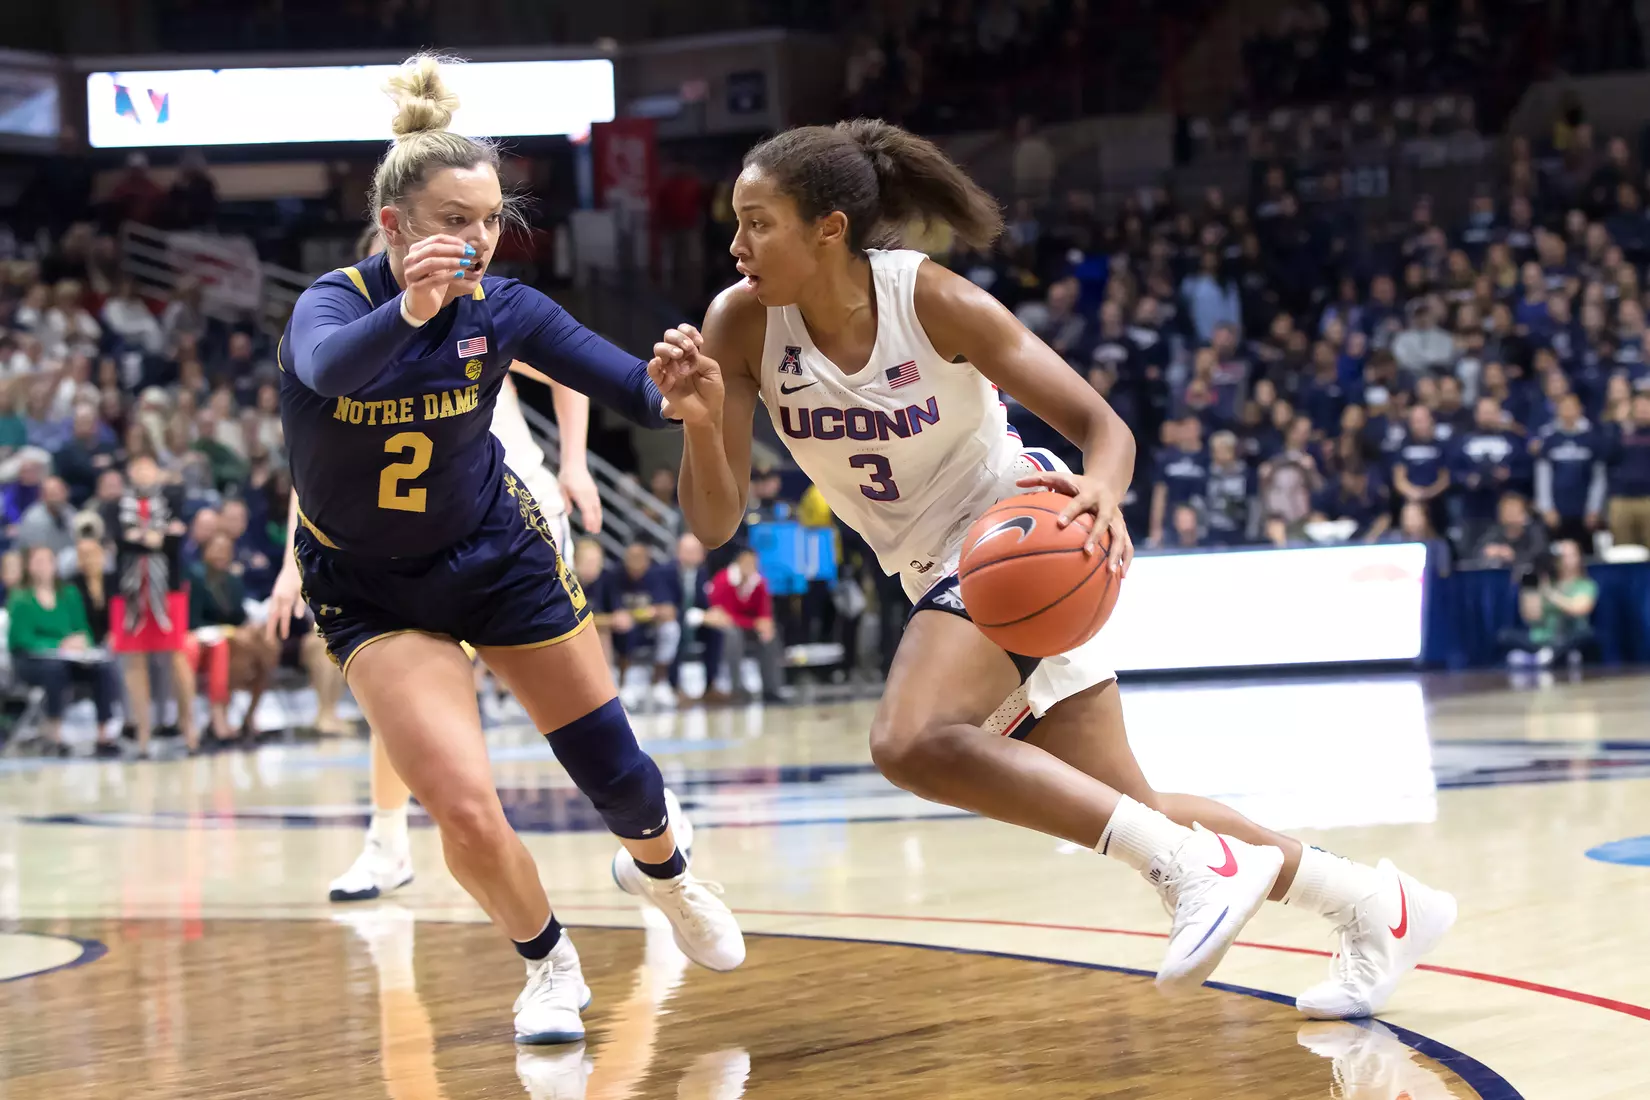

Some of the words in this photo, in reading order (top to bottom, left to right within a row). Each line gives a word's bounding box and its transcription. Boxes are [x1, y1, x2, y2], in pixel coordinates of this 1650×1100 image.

[466, 363, 482, 375] ACC
[332, 395, 415, 426] NOTRE
[423, 384, 480, 420] DAME
[779, 395, 941, 441] UCONN
[378, 431, 434, 513] 2
[848, 453, 900, 502] 3
